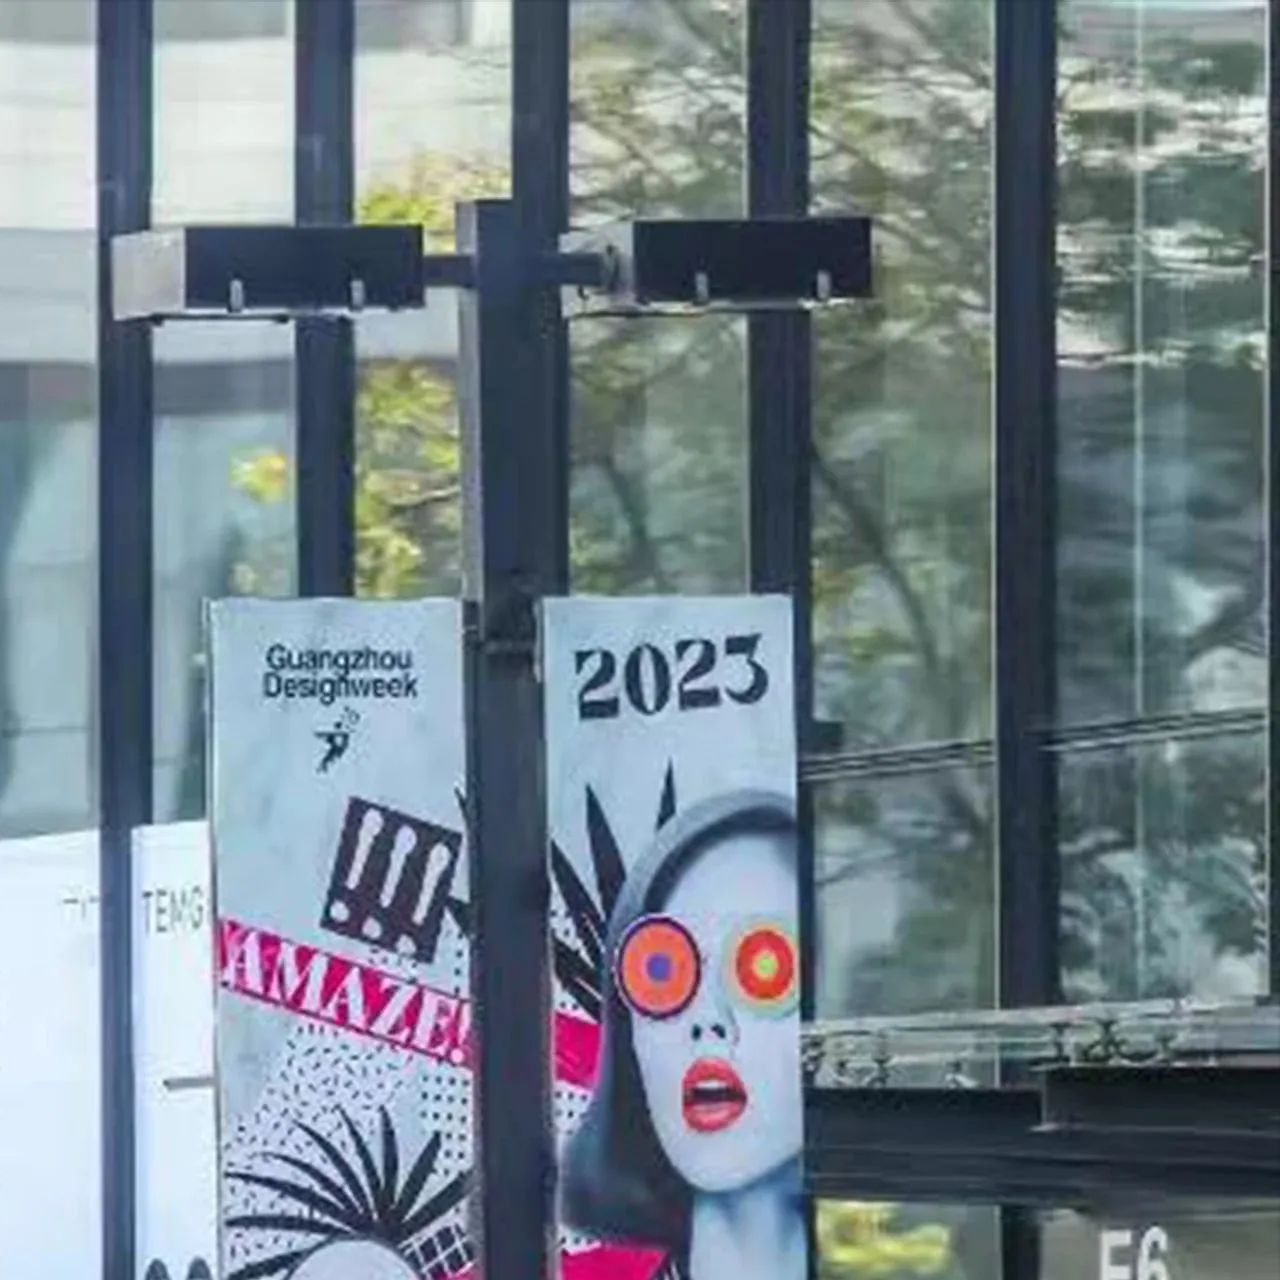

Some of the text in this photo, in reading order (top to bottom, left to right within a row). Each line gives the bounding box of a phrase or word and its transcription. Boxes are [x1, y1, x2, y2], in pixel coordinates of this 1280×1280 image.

[264, 671, 418, 706] Designweek
[266, 643, 413, 675] Guangzhou
[575, 633, 768, 720] 2023
[223, 928, 474, 1064] AMAZE!
